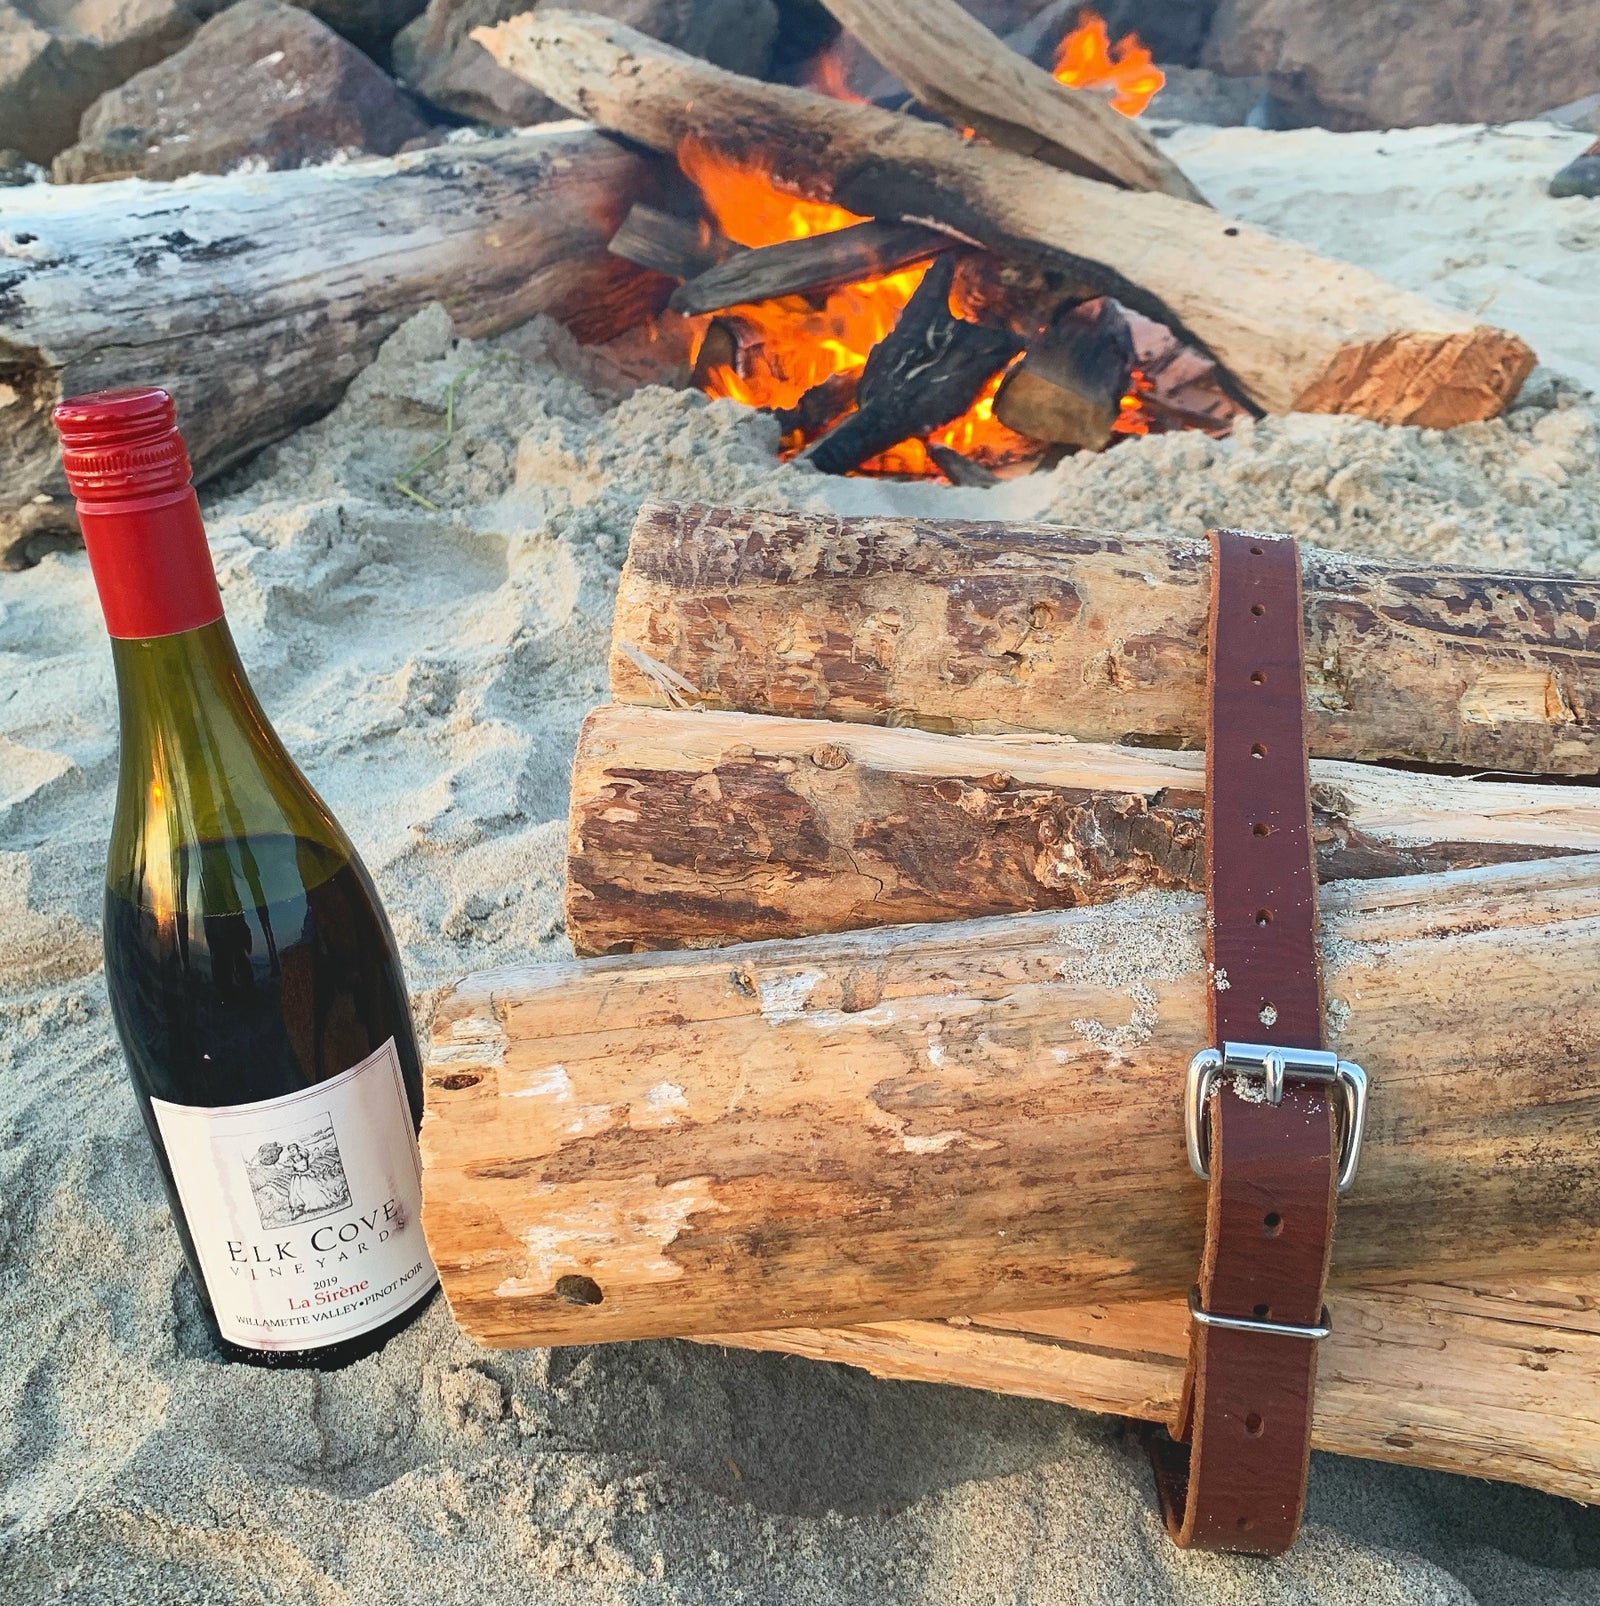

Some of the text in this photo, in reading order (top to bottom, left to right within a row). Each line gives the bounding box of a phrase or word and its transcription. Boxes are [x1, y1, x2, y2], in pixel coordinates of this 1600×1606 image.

[227, 1198, 399, 1263] ELK COVE
[230, 1220, 405, 1281] VINEYARDS
[236, 1315, 310, 1327] WILLAMETTE
[399, 1262, 424, 1284] NOIR
[288, 1278, 370, 1311] La Sirène
[313, 1276, 338, 1291] 2019
